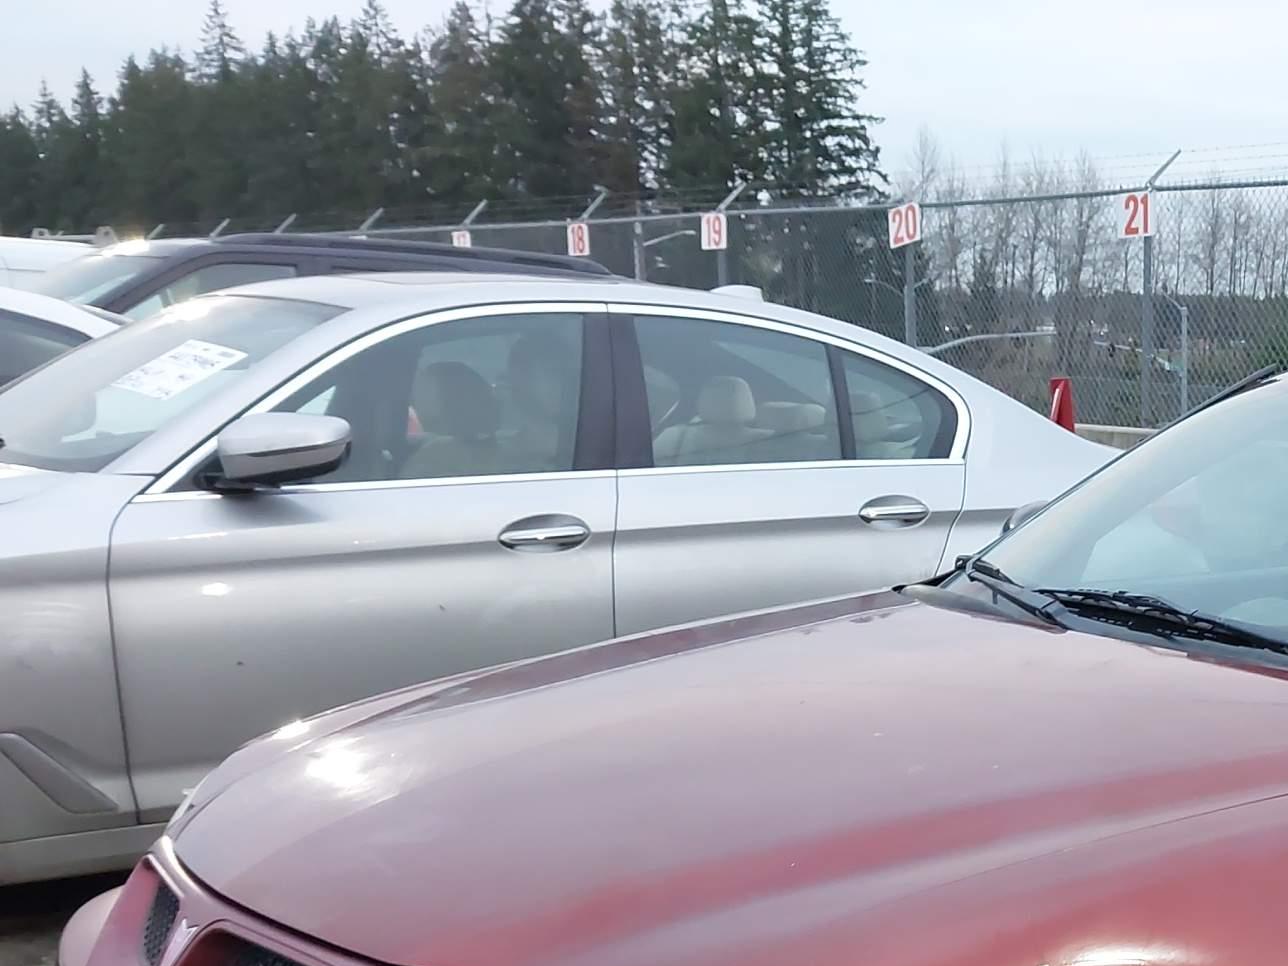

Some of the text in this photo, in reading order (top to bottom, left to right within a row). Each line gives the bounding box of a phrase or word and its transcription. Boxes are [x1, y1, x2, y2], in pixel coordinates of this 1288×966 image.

[706, 215, 721, 247] 19
[892, 204, 917, 245] 20
[1124, 193, 1149, 236] 21
[571, 225, 585, 254] 18
